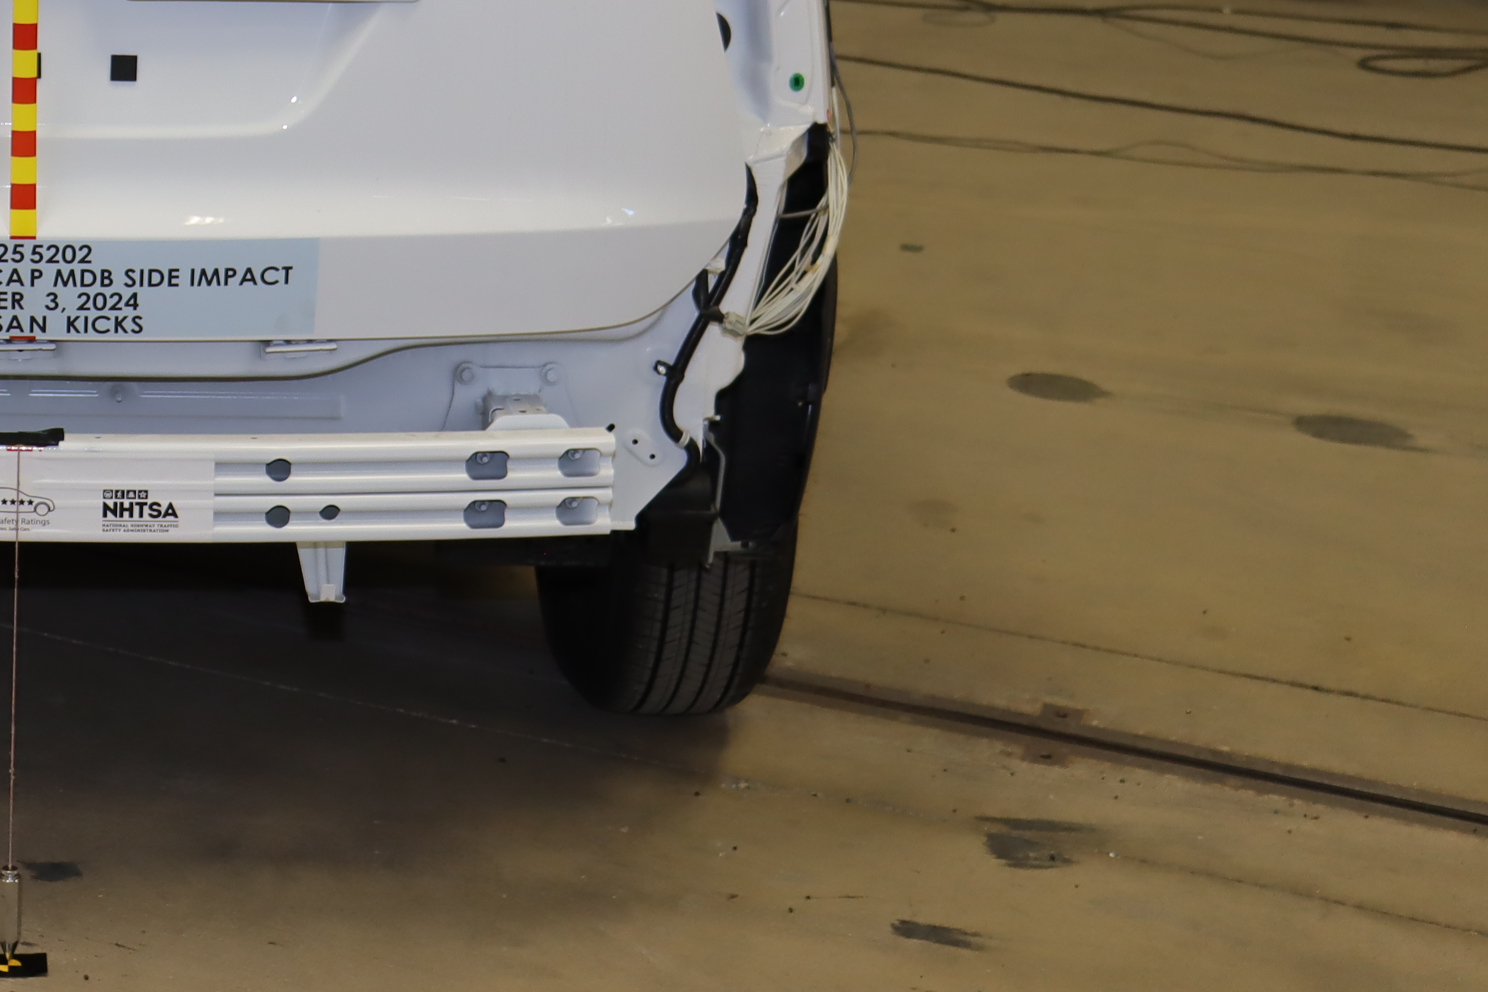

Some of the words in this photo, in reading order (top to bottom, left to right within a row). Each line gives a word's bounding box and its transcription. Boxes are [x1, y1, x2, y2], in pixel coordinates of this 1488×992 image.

[53, 269, 113, 287] MDB
[124, 269, 179, 287] SIDE
[190, 266, 293, 286] IMPACT
[45, 292, 65, 313] 3,
[76, 292, 139, 311] 2024
[67, 316, 143, 334] KICKS
[103, 502, 178, 518] NHTSA
[21, 518, 50, 527] Ratings
